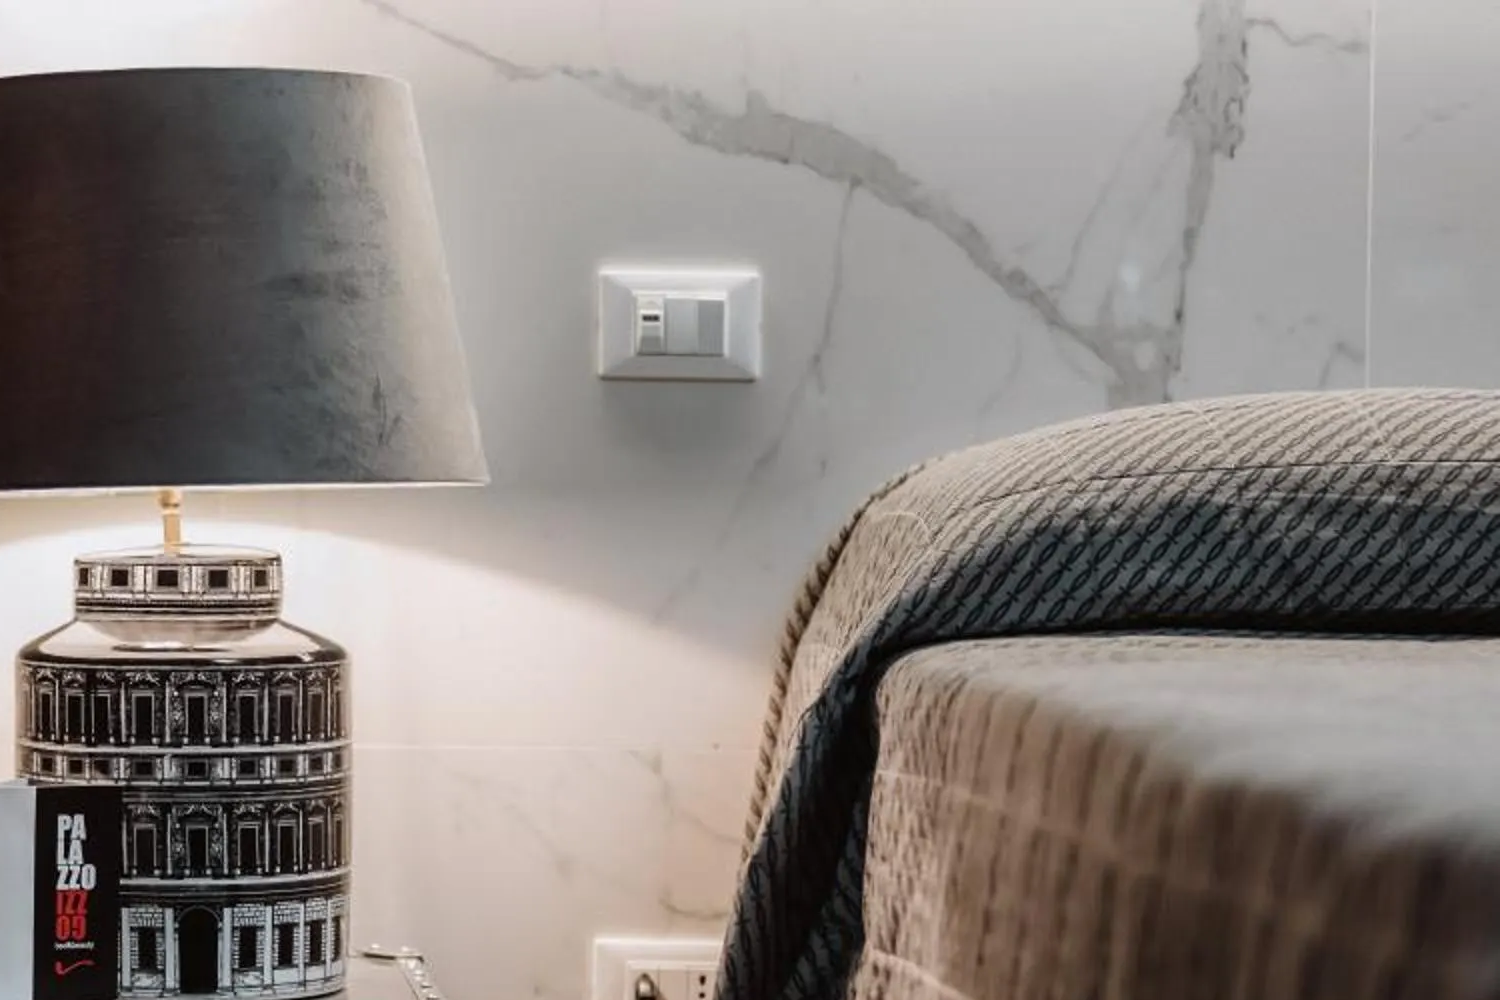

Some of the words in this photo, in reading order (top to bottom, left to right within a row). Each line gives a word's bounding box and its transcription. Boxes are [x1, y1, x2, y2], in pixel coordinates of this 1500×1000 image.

[57, 813, 87, 840] PA
[57, 840, 83, 864] LA
[56, 863, 97, 890] ZZO
